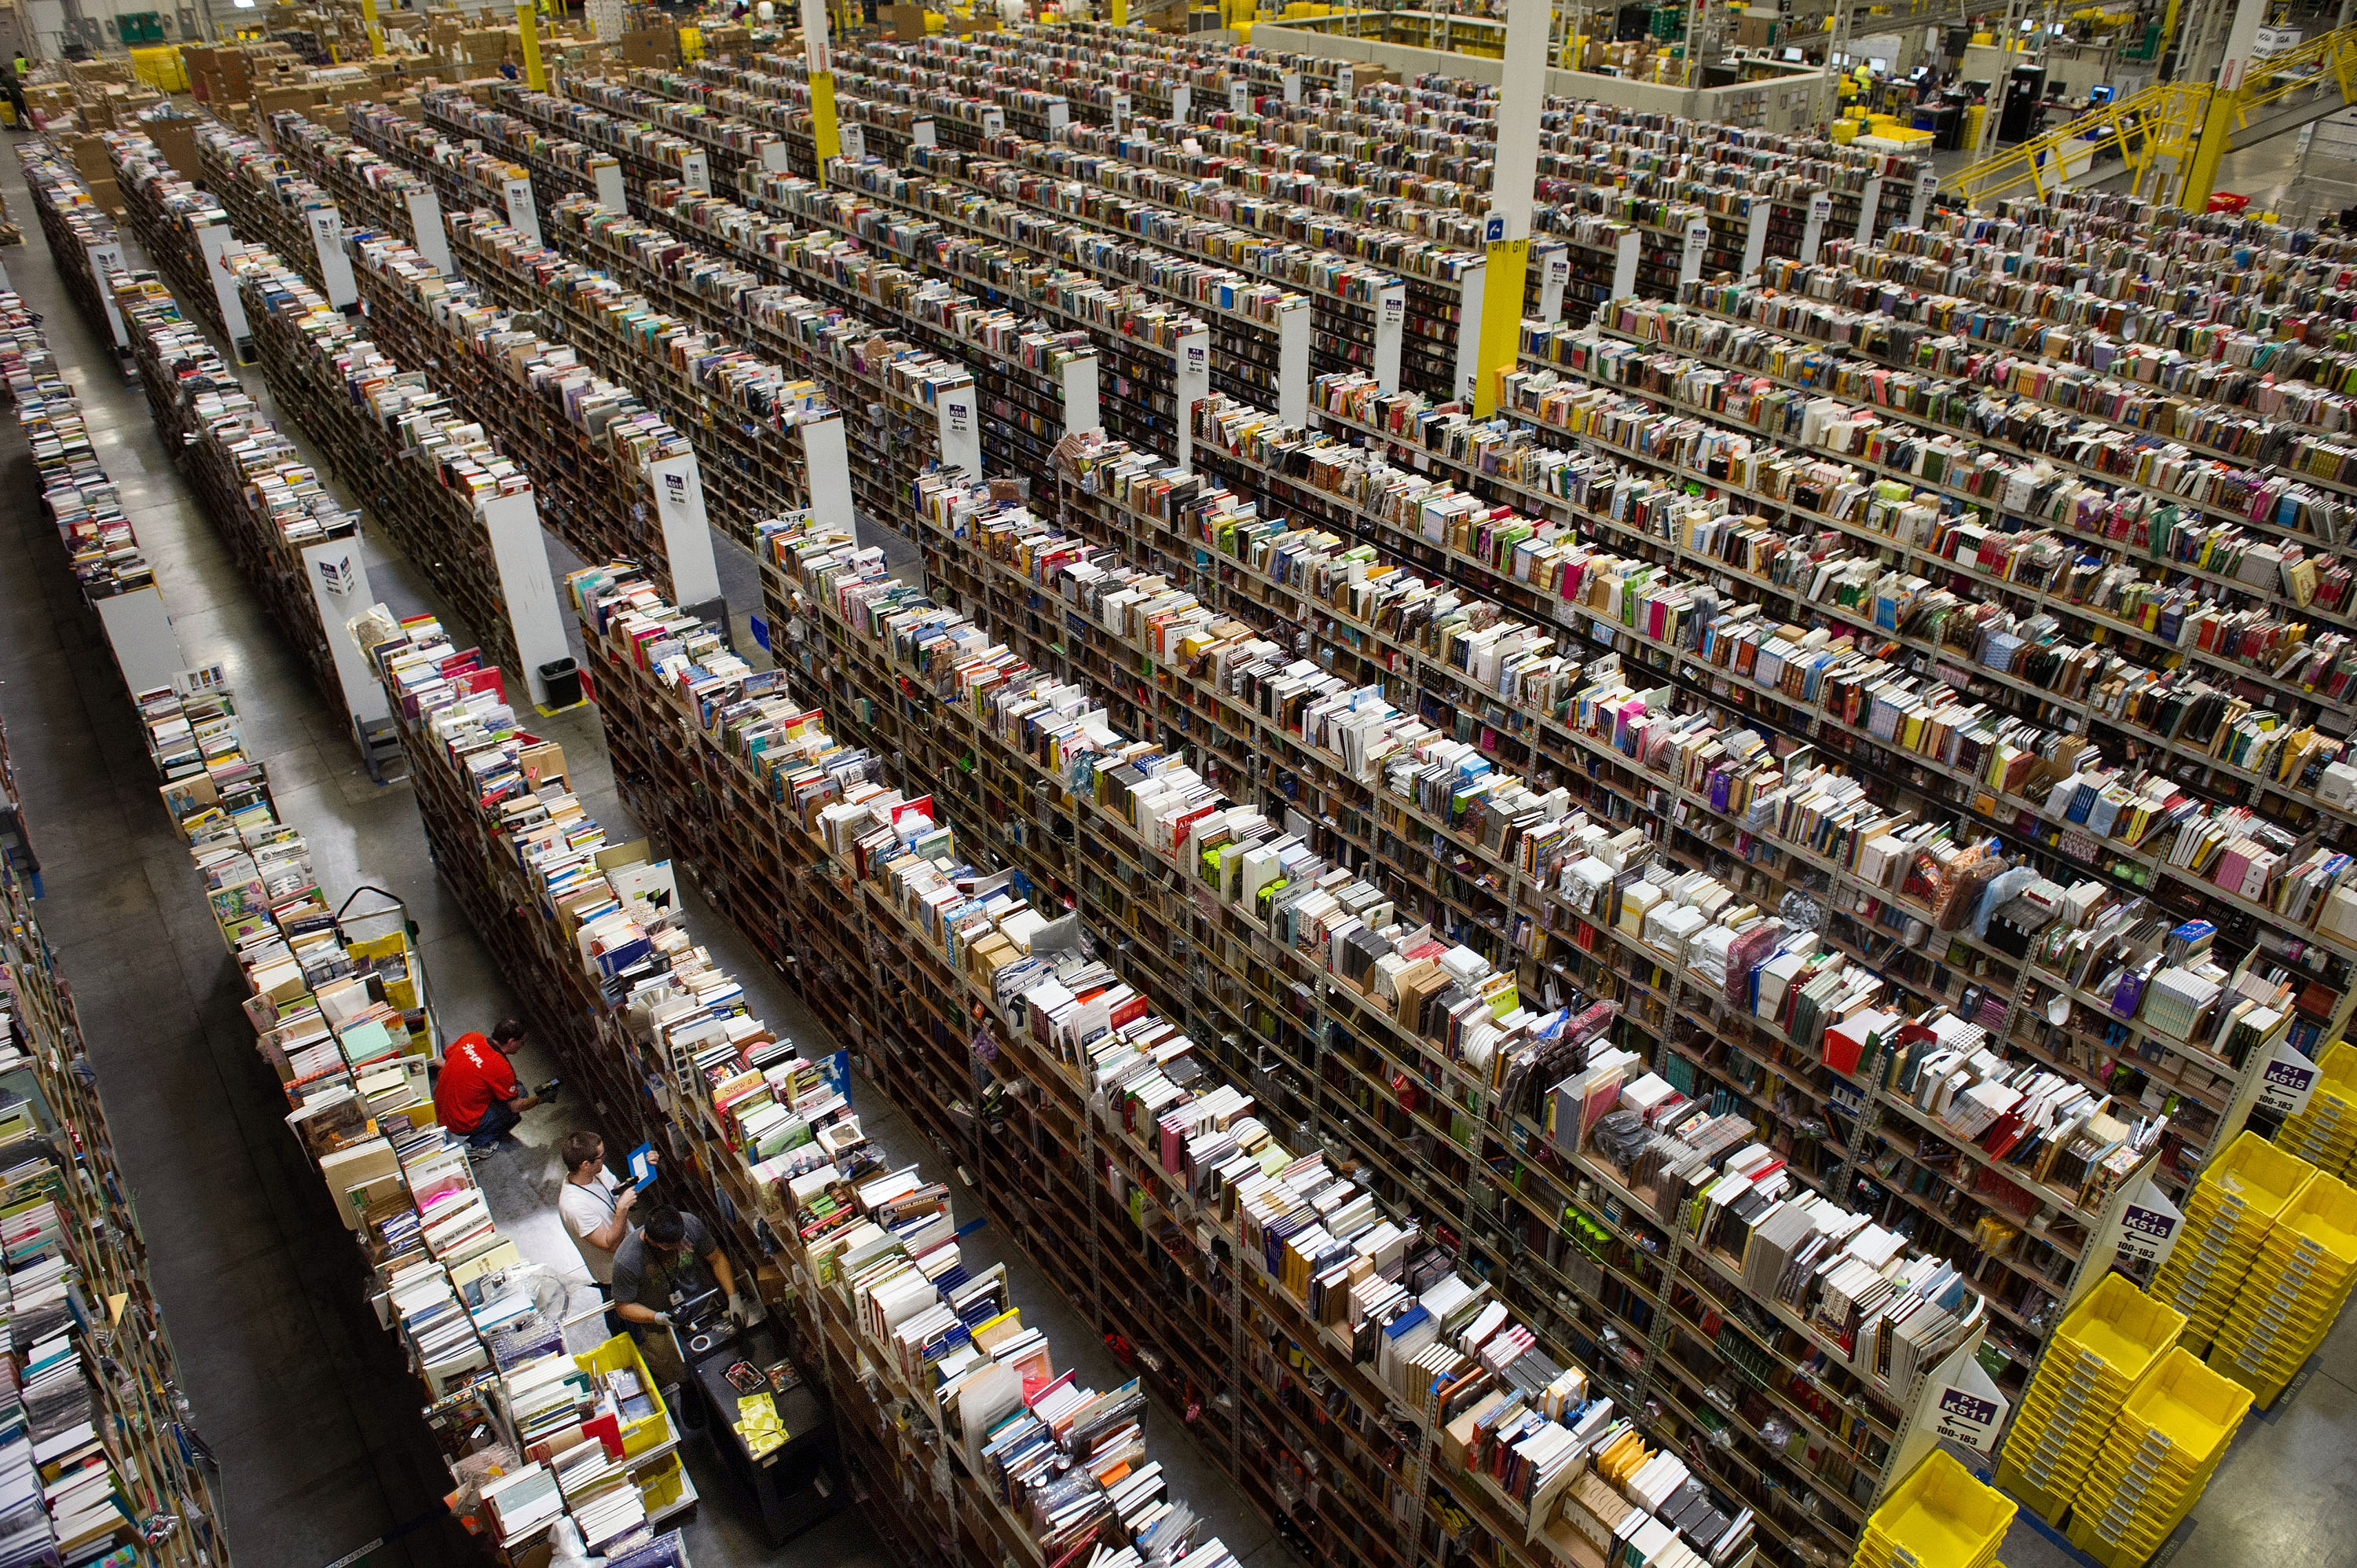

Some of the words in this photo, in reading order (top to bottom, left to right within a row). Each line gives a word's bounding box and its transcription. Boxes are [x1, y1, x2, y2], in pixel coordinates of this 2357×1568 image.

[1512, 240, 1526, 253] G11
[270, 844, 302, 855] Vacmaster
[1274, 888, 1301, 905] Breville
[948, 902, 982, 918] BECO
[946, 920, 955, 966] GEMINI
[1012, 984, 1025, 993] TEAM
[1025, 972, 1043, 986] MAGNET
[1115, 1075, 1127, 1084] TEAM
[1128, 1063, 1149, 1077] MAGNET
[2267, 1071, 2307, 1089] K515
[2282, 1065, 2300, 1075] P-1
[724, 1080, 746, 1096] Stew
[2258, 1094, 2293, 1111] 100-183
[456, 1225, 471, 1236] truck
[472, 1215, 487, 1225] book
[2125, 1216, 2168, 1236] K513
[2141, 1211, 2160, 1222] P-1
[2117, 1241, 2156, 1258] 100-183
[1822, 1284, 1835, 1307] Baking
[1831, 1290, 1842, 1313] Baking
[2280, 1387, 2295, 1405] EMPTY
[2292, 1372, 2308, 1390] TOTES
[1944, 1400, 1989, 1422] K511
[1960, 1395, 1980, 1408] P-1
[1937, 1425, 1978, 1446] 100-183
[347, 1540, 380, 1562] POWER
[2162, 1541, 2183, 1562] TOTES
